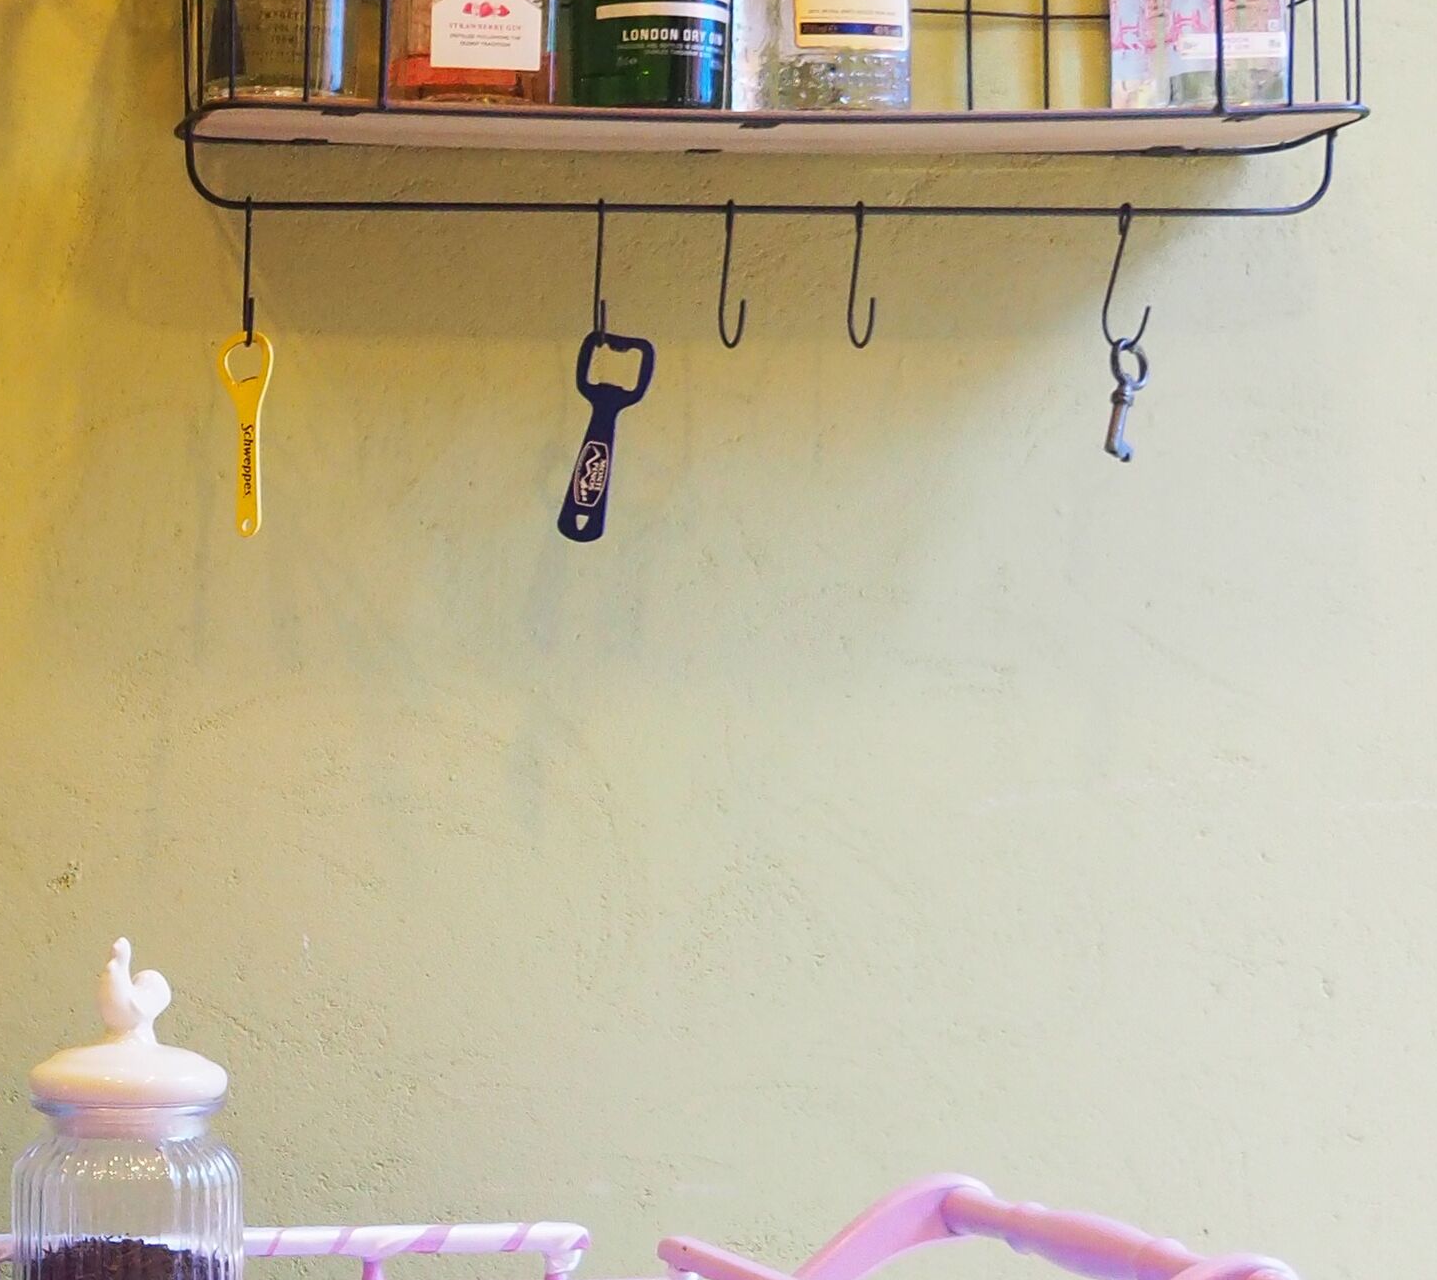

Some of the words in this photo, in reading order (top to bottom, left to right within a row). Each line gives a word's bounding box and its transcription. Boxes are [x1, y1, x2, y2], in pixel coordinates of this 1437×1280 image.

[622, 28, 680, 42] LONDON
[682, 28, 707, 43] DRY
[240, 423, 255, 496] Schweppes
